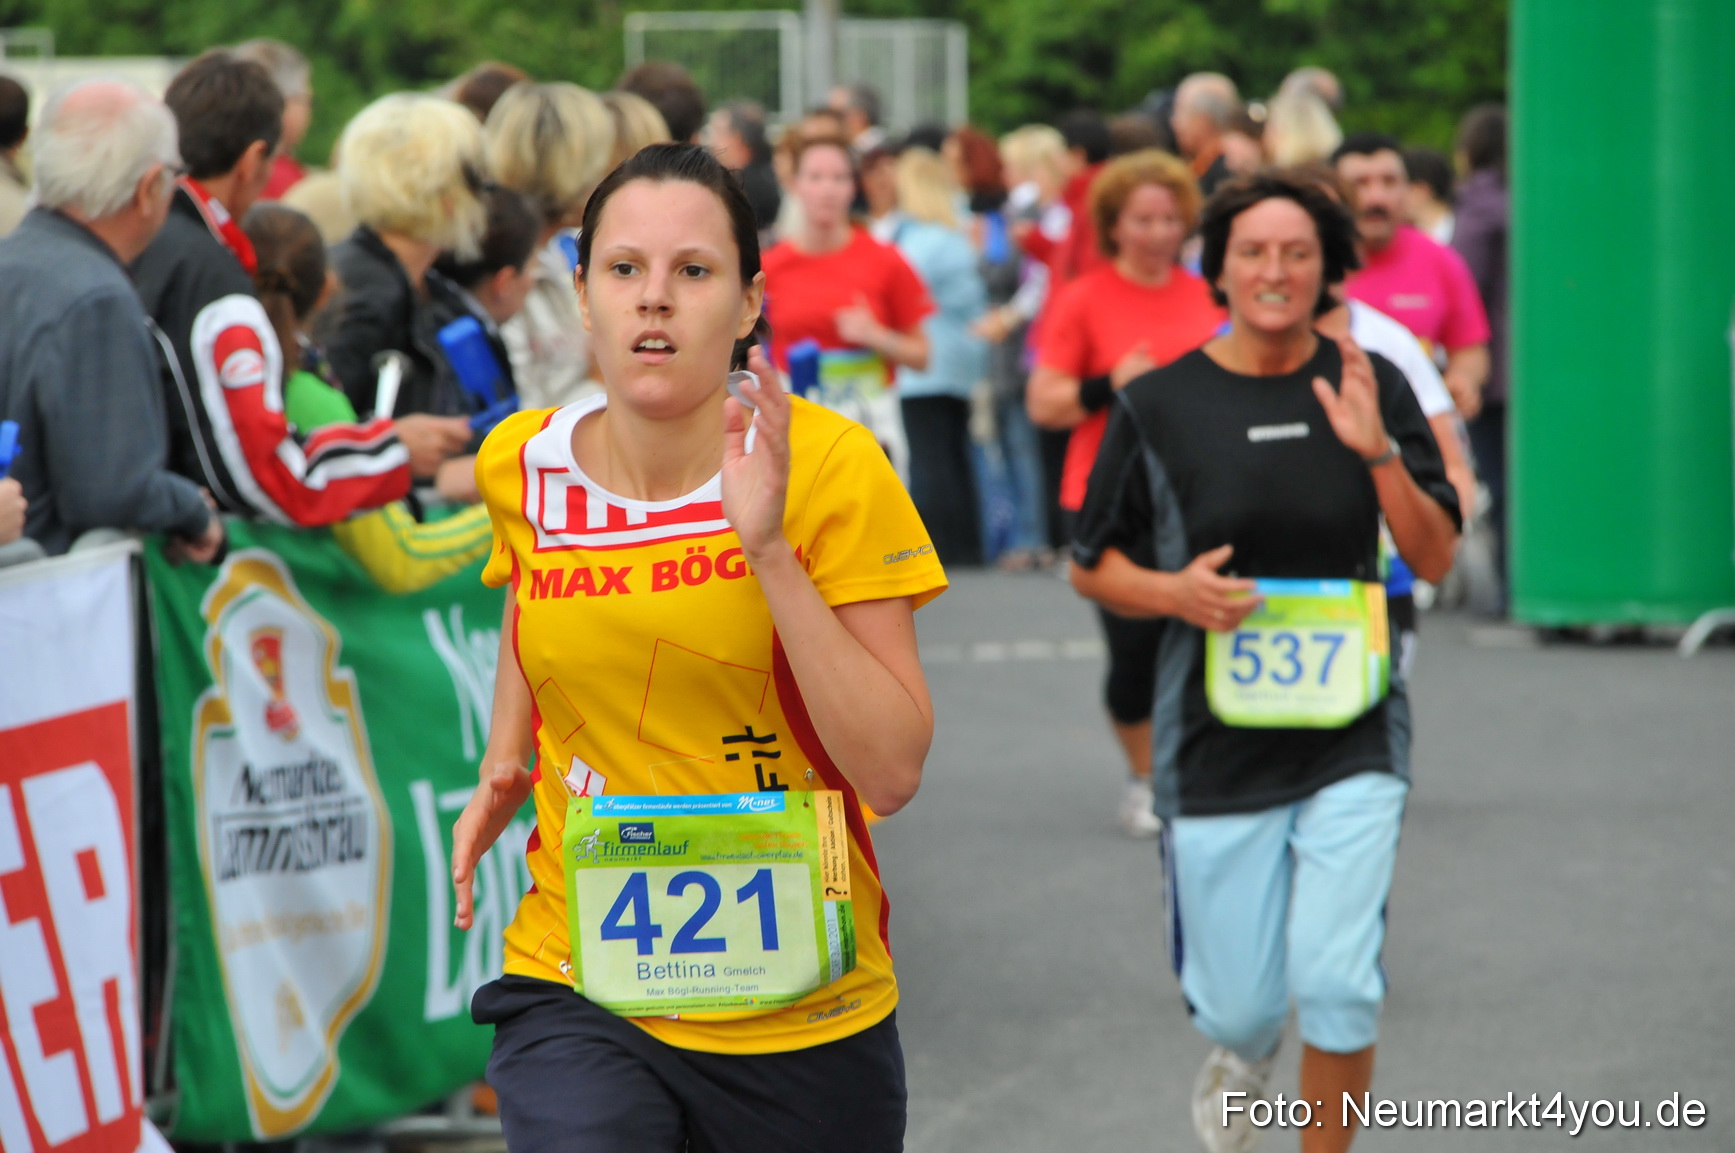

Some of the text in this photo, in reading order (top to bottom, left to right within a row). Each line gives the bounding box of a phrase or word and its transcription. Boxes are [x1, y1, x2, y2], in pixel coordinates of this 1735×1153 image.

[530, 545, 757, 600] MAX BÖG
[1230, 631, 1345, 685] 537
[603, 840, 689, 856] firmenlauf
[600, 868, 779, 956] 421
[636, 961, 766, 981] Bettina Gmelch
[646, 984, 759, 996] Max Bögl-Running-Team
